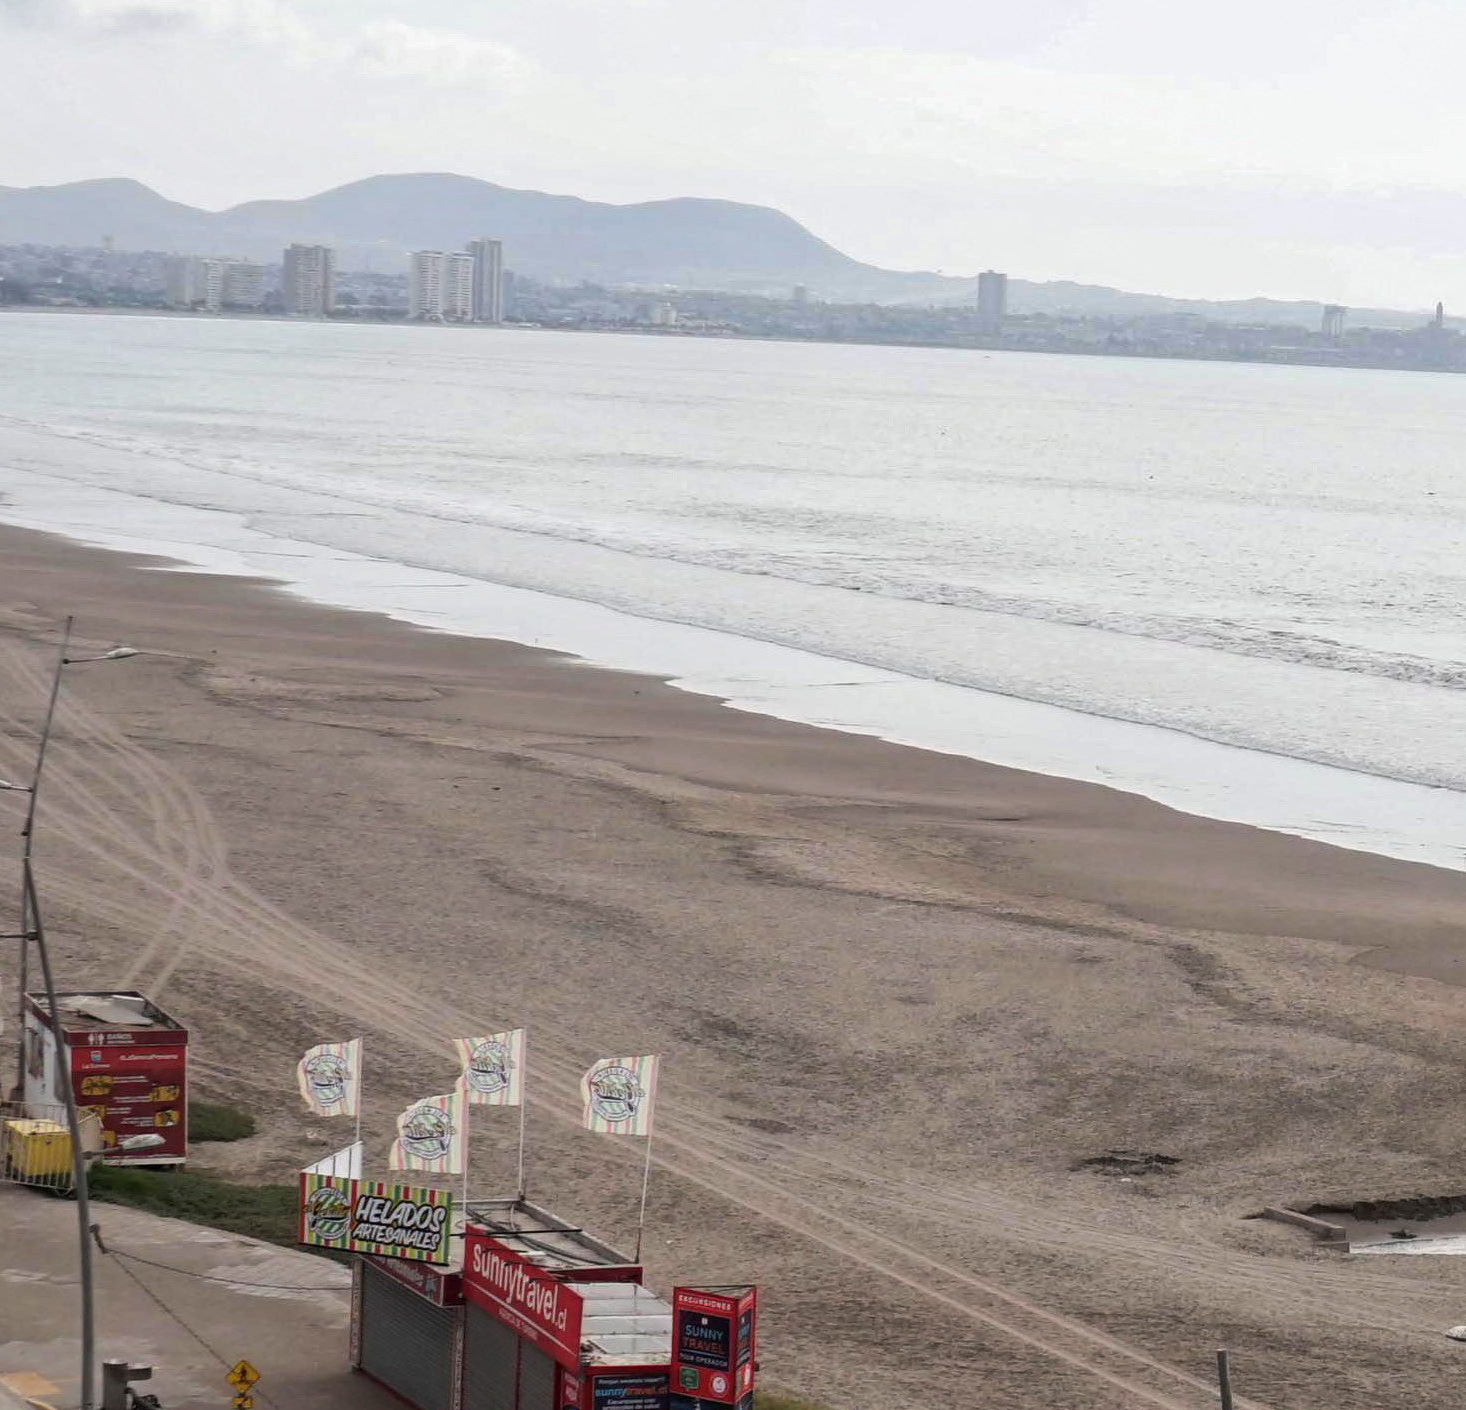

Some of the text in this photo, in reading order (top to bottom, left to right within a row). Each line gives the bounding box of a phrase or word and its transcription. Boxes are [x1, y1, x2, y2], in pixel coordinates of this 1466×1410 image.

[355, 1196, 446, 1232] HELADOS
[352, 1223, 441, 1250] ARTESANALES
[678, 1294, 731, 1310] EXCURSIONES
[685, 1324, 724, 1340] SUNNY
[682, 1337, 726, 1354] TRAVEL
